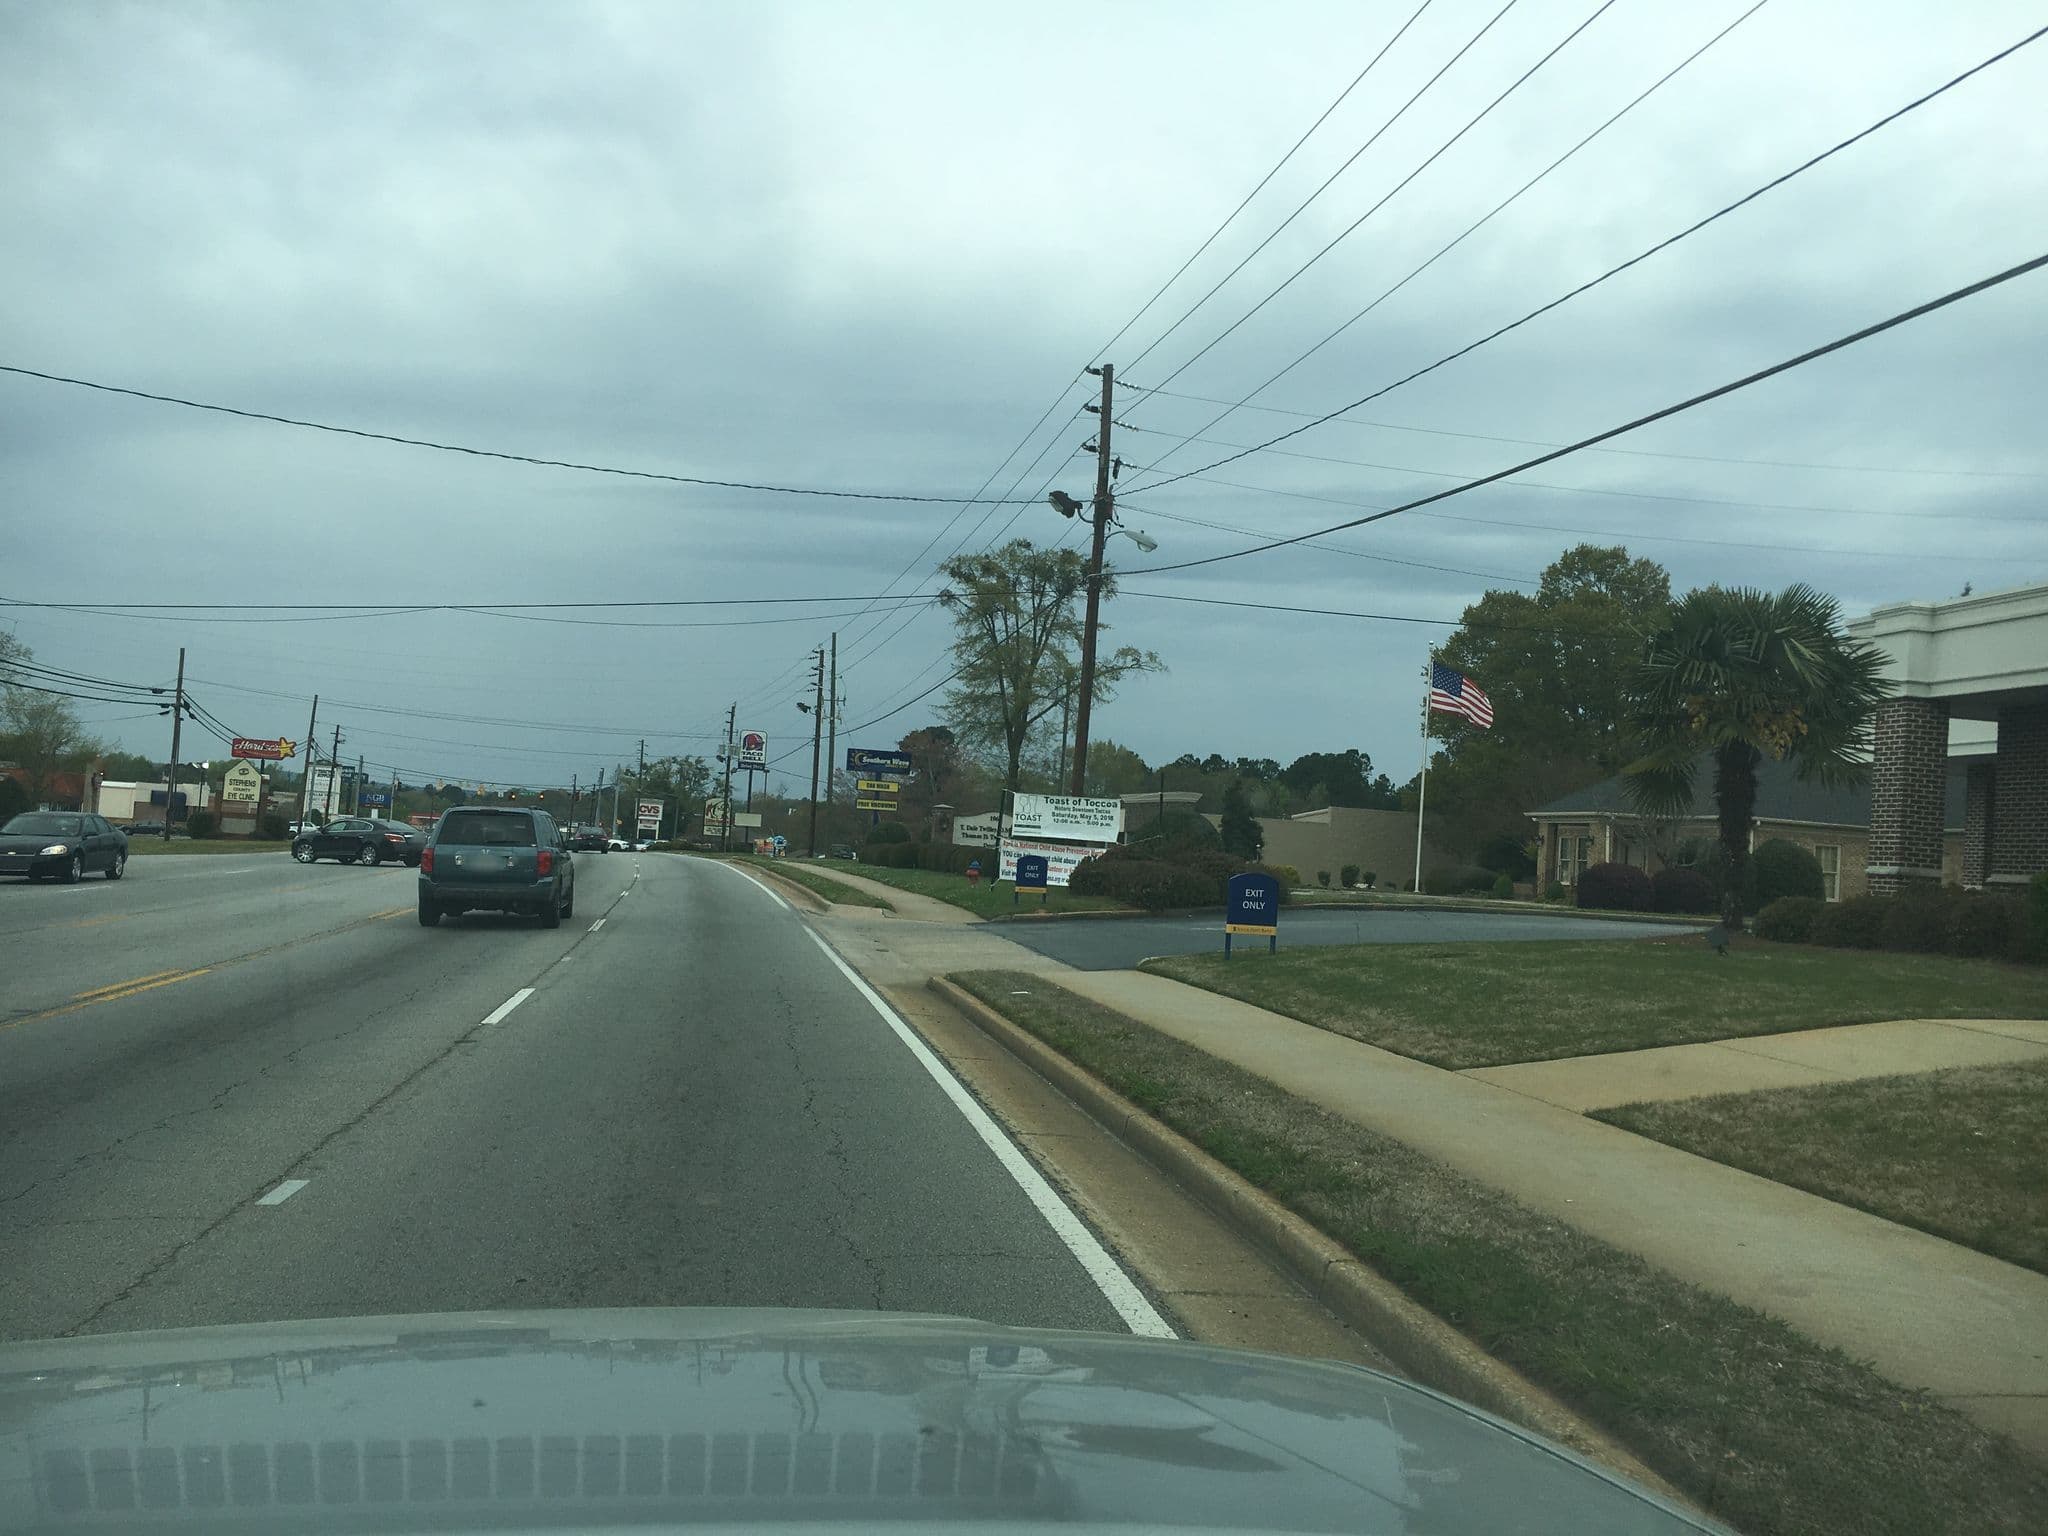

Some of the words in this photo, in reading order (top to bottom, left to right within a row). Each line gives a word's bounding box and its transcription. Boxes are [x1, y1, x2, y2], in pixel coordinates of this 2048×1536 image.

[862, 756, 891, 764] Southern
[229, 779, 256, 787] STEPHENS
[1044, 796, 1069, 806] Toast
[1072, 798, 1081, 806] of
[1085, 799, 1118, 808] Toccoa
[640, 805, 660, 814] CVS
[1051, 811, 1078, 819] Saturday,
[1039, 843, 1052, 851] Child
[1245, 889, 1264, 897] EXIT
[1242, 901, 1265, 910] ONLY
